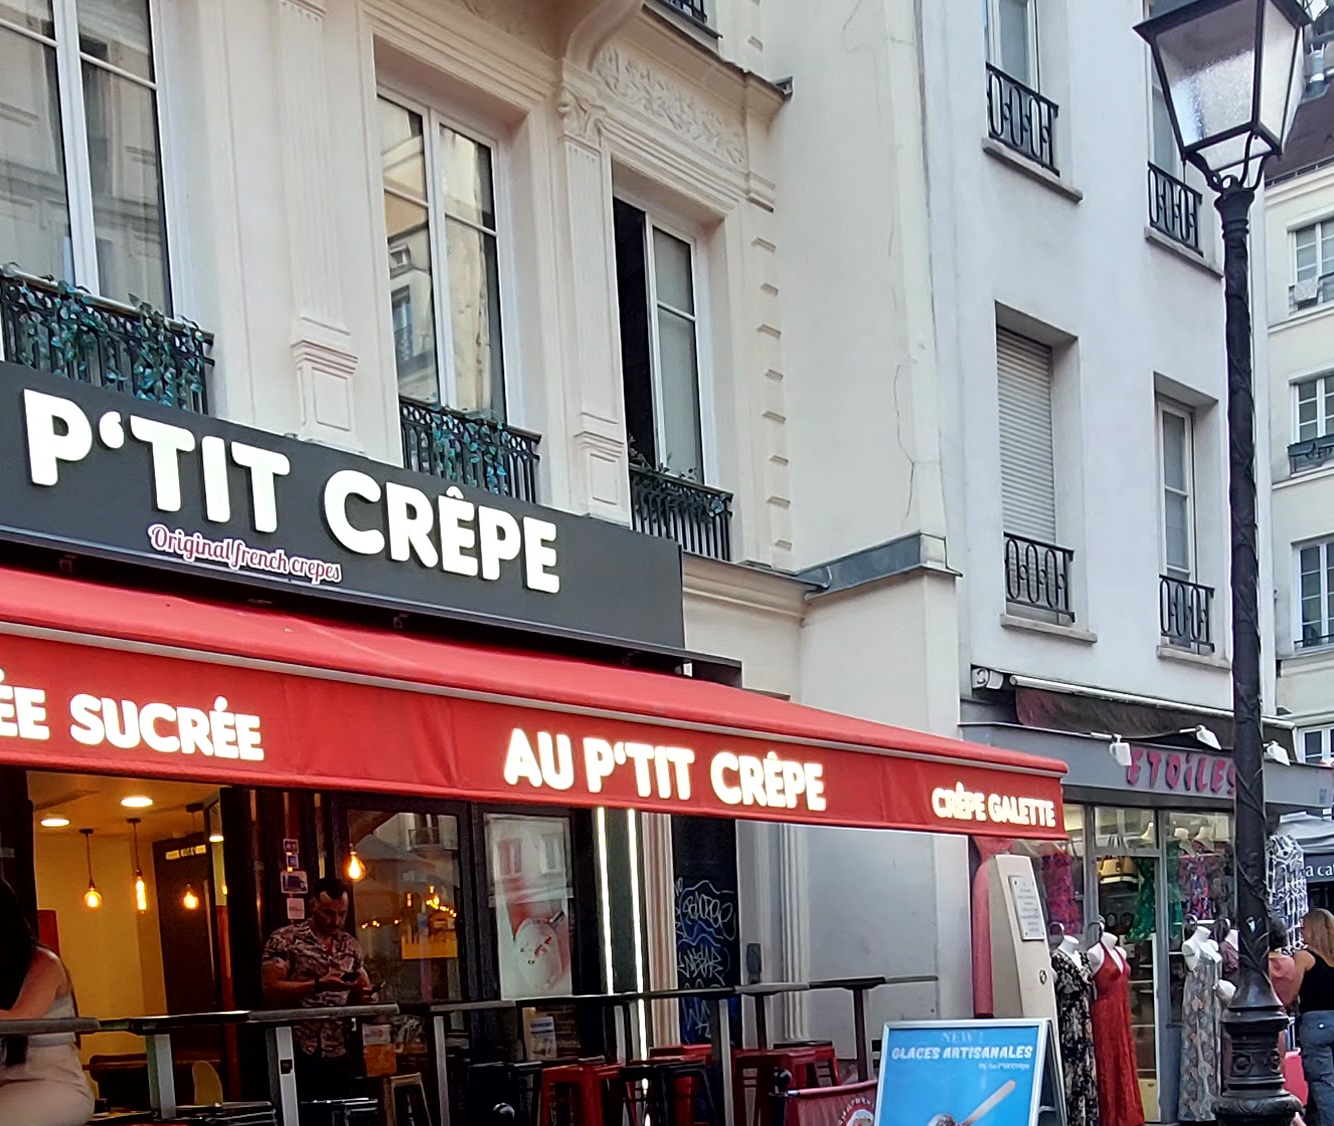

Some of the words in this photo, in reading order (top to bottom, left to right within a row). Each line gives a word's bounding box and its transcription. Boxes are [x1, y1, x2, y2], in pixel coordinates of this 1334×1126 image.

[149, 525, 232, 563] Original
[230, 538, 289, 571] french
[289, 556, 342, 585] crepes
[323, 470, 561, 593] CRÊPE
[69, 695, 265, 762] SUCRÉE
[503, 728, 575, 790] AU
[710, 751, 827, 811] CRÊPE
[987, 794, 1056, 828] GALETTE
[891, 1047, 940, 1060] GLACES
[942, 1045, 1033, 1059] ARTISANALES
